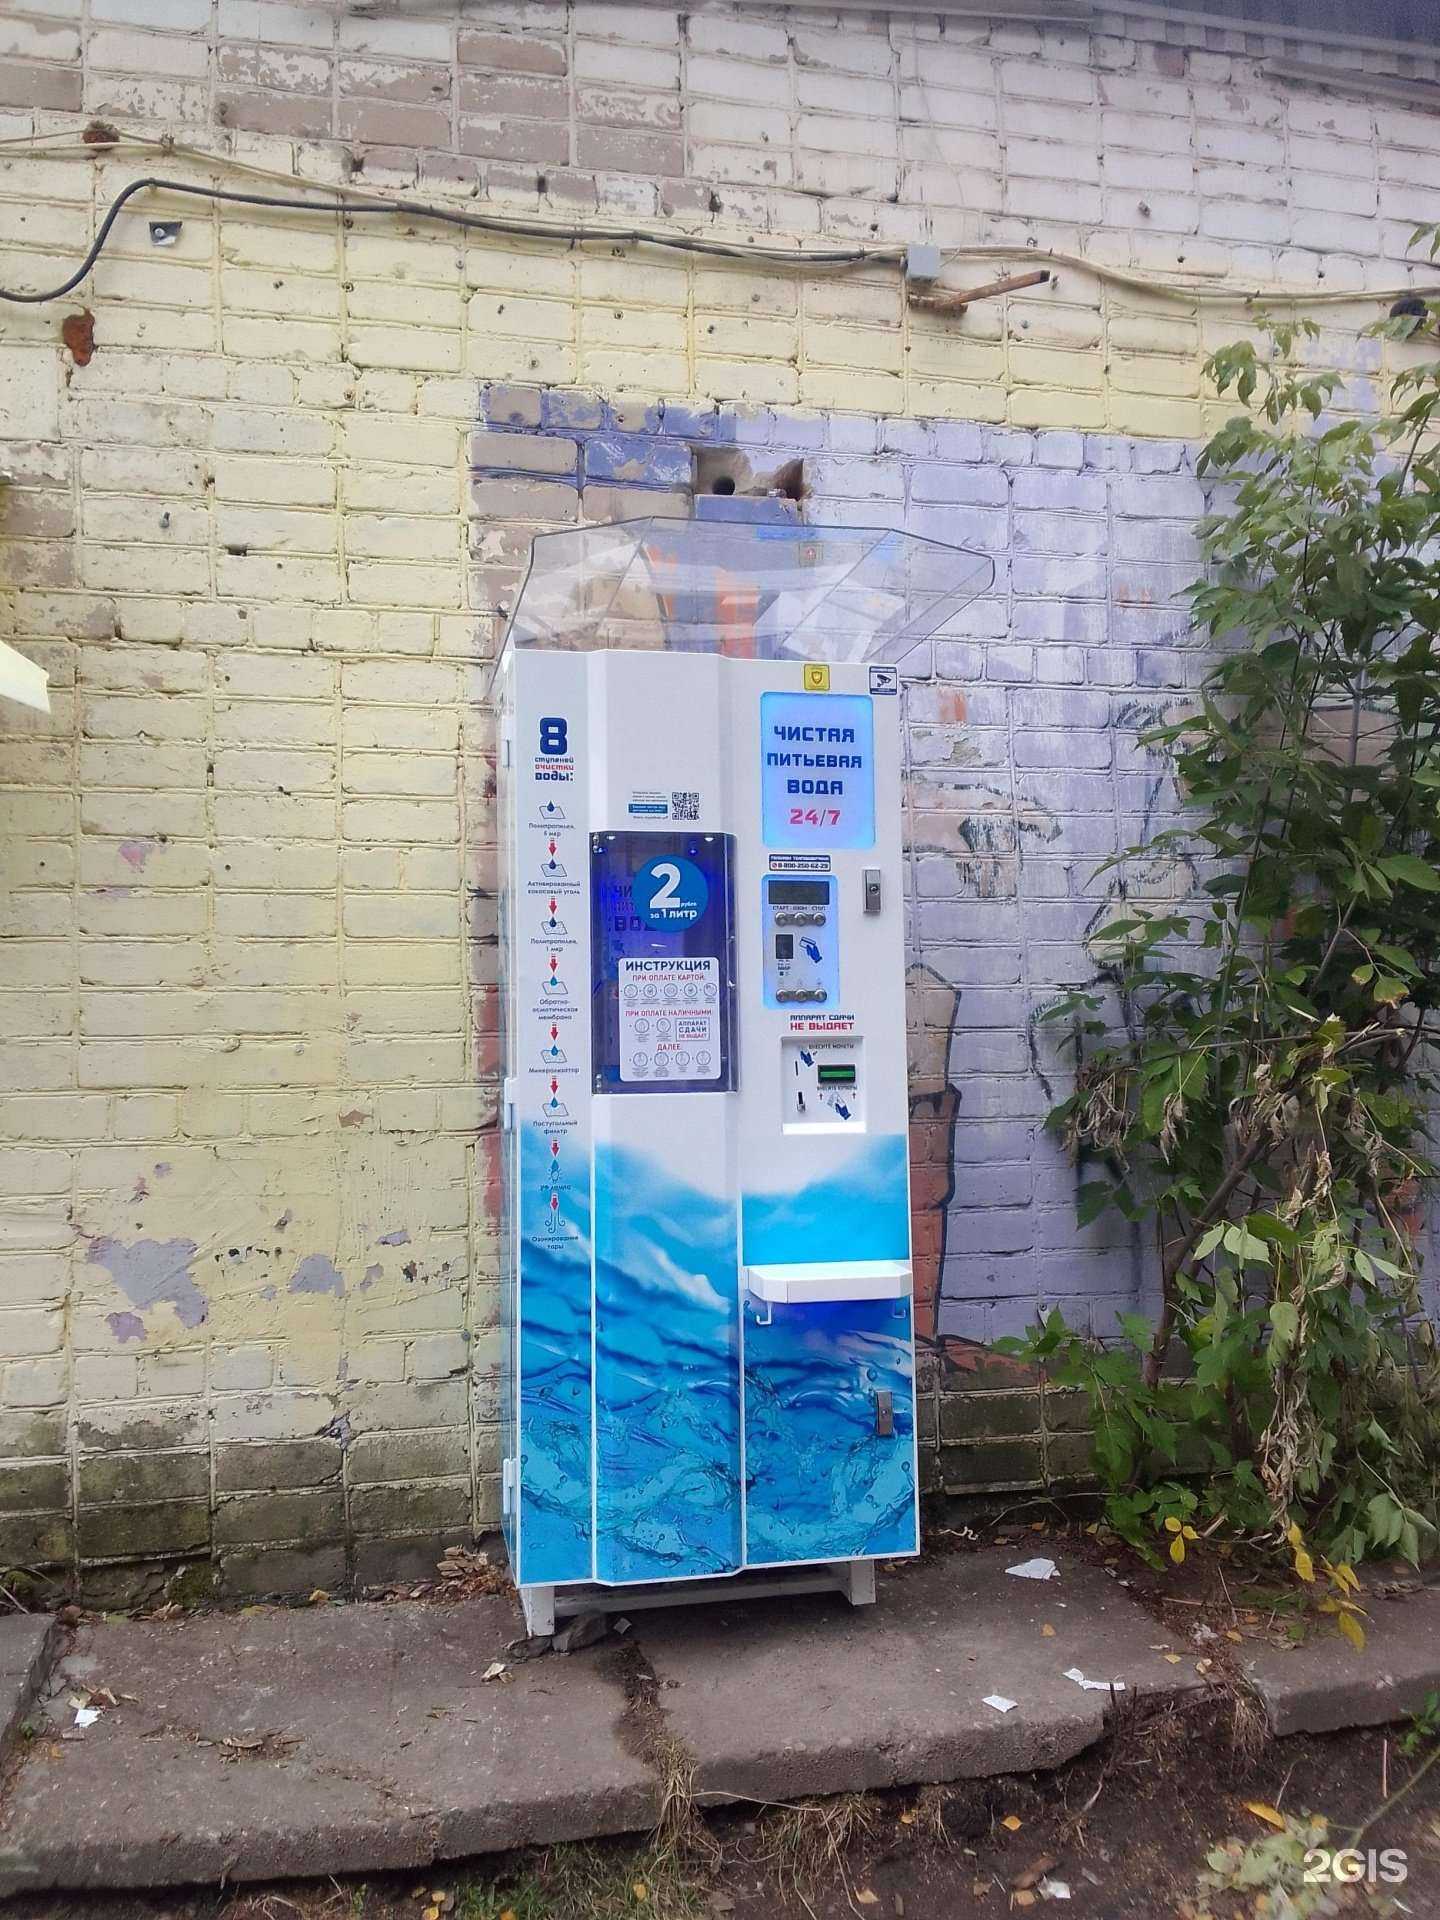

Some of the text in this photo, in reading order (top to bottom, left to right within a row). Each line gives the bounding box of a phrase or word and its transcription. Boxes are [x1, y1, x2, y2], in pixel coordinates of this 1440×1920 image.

[540, 717, 568, 756] 8
[773, 725, 855, 744] ЧИСТАЯ
[534, 756, 574, 764] ступеней
[766, 751, 862, 769] ПИТЬЕВАЯ
[534, 763, 574, 771] очистки
[535, 770, 574, 782] воды:
[786, 778, 844, 796] ВОДА
[789, 807, 842, 827] 24/7
[649, 862, 681, 909] 2
[661, 908, 667, 919] 1
[668, 909, 698, 921] литр
[625, 960, 711, 973] ИНСТРУКЦИЯ
[632, 973, 705, 982] ПРИ ОПЛАТЕ КАРТОЙ
[790, 1022, 854, 1031] НЕ ВЫДАЕТ
[657, 1043, 681, 1051] ДАЛЕЕ
